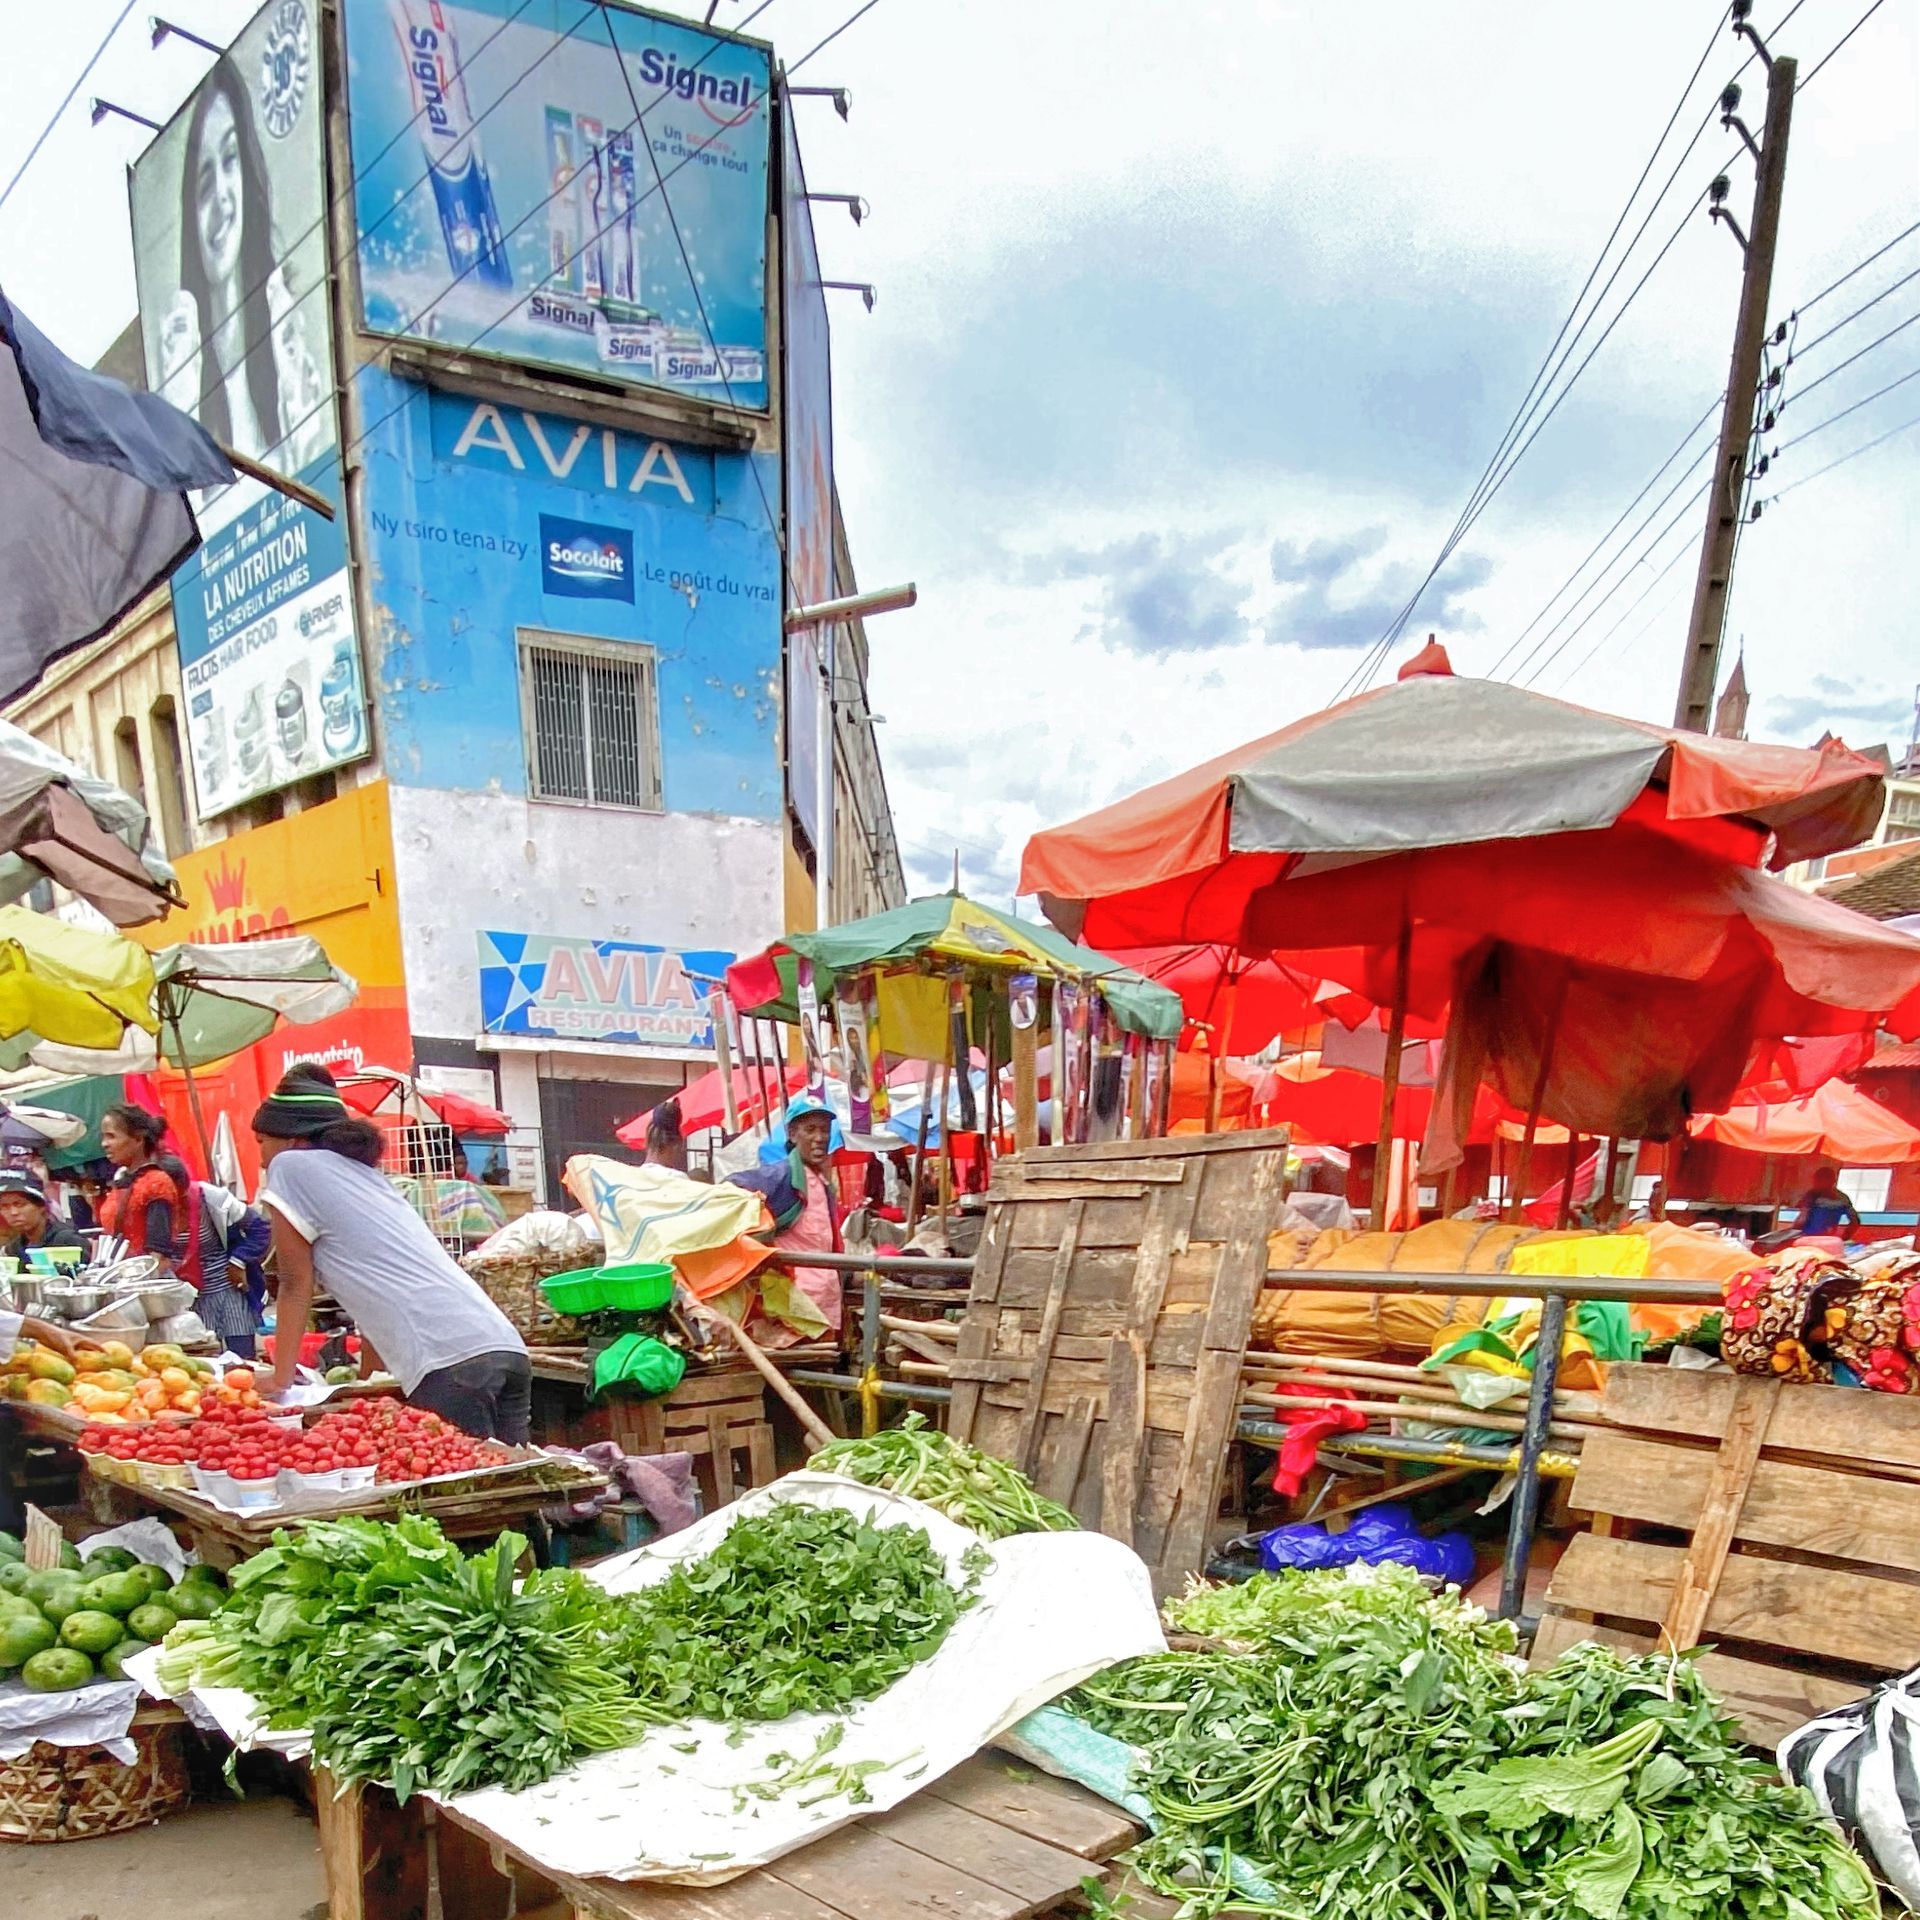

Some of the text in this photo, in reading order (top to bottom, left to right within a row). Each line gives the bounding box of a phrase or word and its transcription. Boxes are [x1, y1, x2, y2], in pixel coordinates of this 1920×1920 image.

[409, 25, 458, 138] Signal
[639, 47, 753, 107] Signal
[664, 125, 682, 140] Un
[671, 143, 718, 166] change
[722, 156, 748, 173] tout
[531, 297, 595, 328] Signal
[609, 338, 652, 360] Signa
[667, 357, 718, 381] Signal
[452, 403, 695, 503] AVIA
[371, 511, 529, 561] Ny tsiro tena izy
[204, 521, 307, 620] LA NUTRITION
[550, 542, 624, 573] Socolait
[645, 562, 776, 602] Le goût du vrai
[207, 619, 225, 645] DES
[224, 591, 266, 633] CHEVEUX
[245, 616, 278, 654] FOOD
[541, 948, 697, 1011] AVIA
[531, 1007, 710, 1036] RESTAURANT
